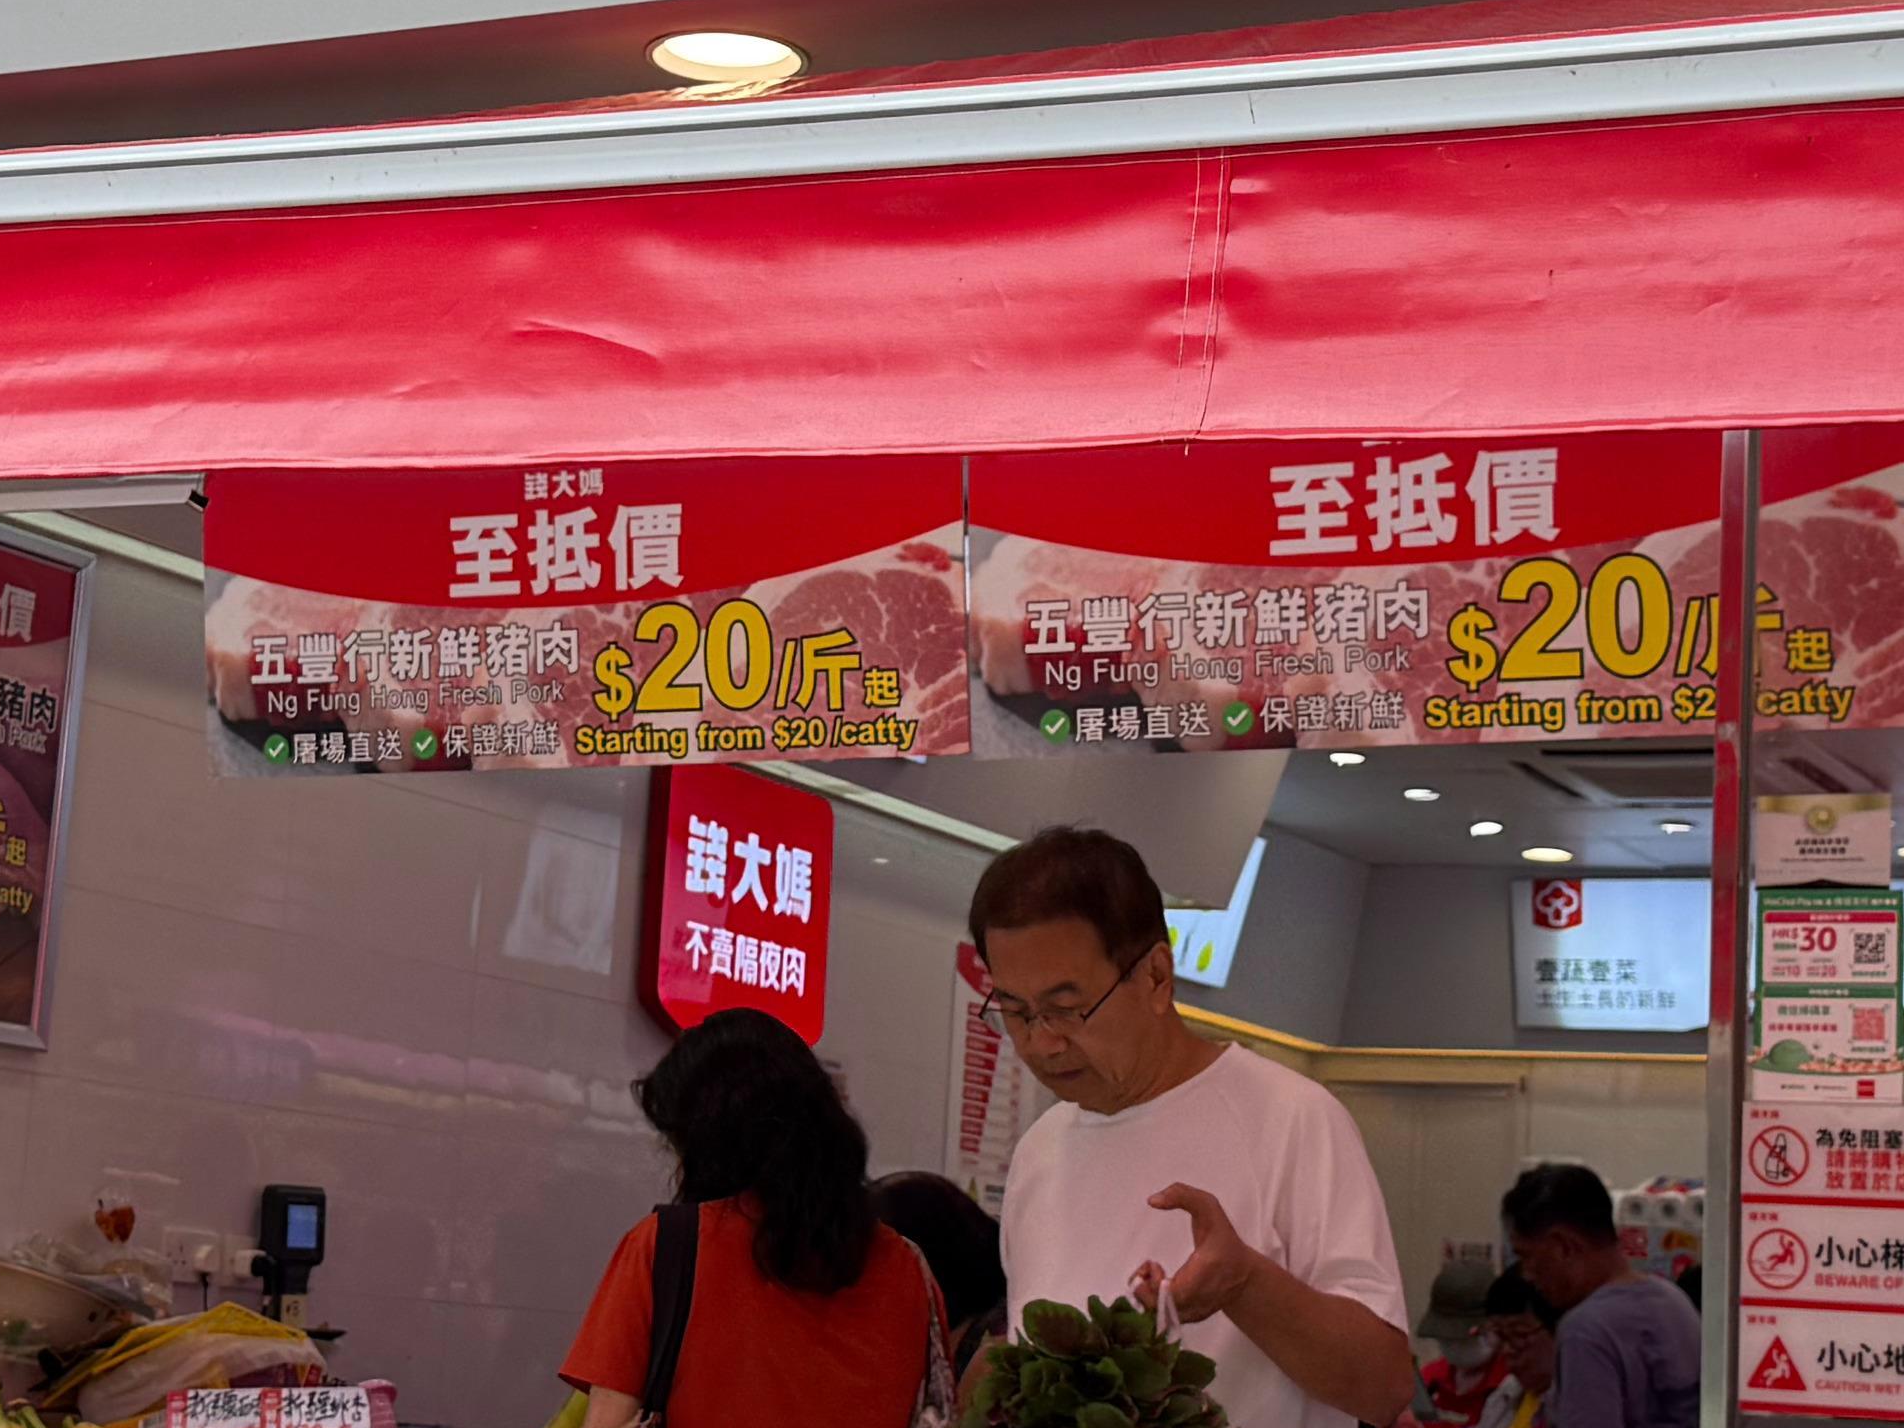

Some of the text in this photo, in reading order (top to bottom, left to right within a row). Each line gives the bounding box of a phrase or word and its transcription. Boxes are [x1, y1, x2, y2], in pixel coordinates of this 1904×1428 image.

[523, 469, 605, 500] 錢大媽
[1269, 447, 1561, 557] 至抵價
[448, 502, 685, 599] 至抵價
[1024, 580, 1430, 654] 五豐行新鮮豬肉
[250, 622, 580, 686] 五豐行新鮮豬肉
[1045, 645, 1411, 691] Ng Fung Hong Fresh Pork
[267, 677, 565, 719] Ng Fung Hong Fresh Pork
[1260, 691, 1406, 733] 保證新鮮
[1424, 690, 1566, 732] Starting
[1576, 690, 1663, 725] from
[1753, 678, 1856, 721] catty
[443, 722, 561, 758] 保證新鮮
[575, 723, 689, 758] Starting
[697, 721, 764, 752] from
[1074, 704, 1212, 743] 屠場直送
[292, 729, 404, 765] 屠場直送
[684, 814, 814, 924] 錢大媽
[684, 920, 808, 998] 不賣隔夜肉
[1799, 926, 1837, 952] 30
[1814, 1273, 1881, 1291] BEWARE
[1883, 1276, 1904, 1291] OF
[1814, 1379, 1871, 1394] CAUTION
[1873, 1381, 1902, 1395] WET
